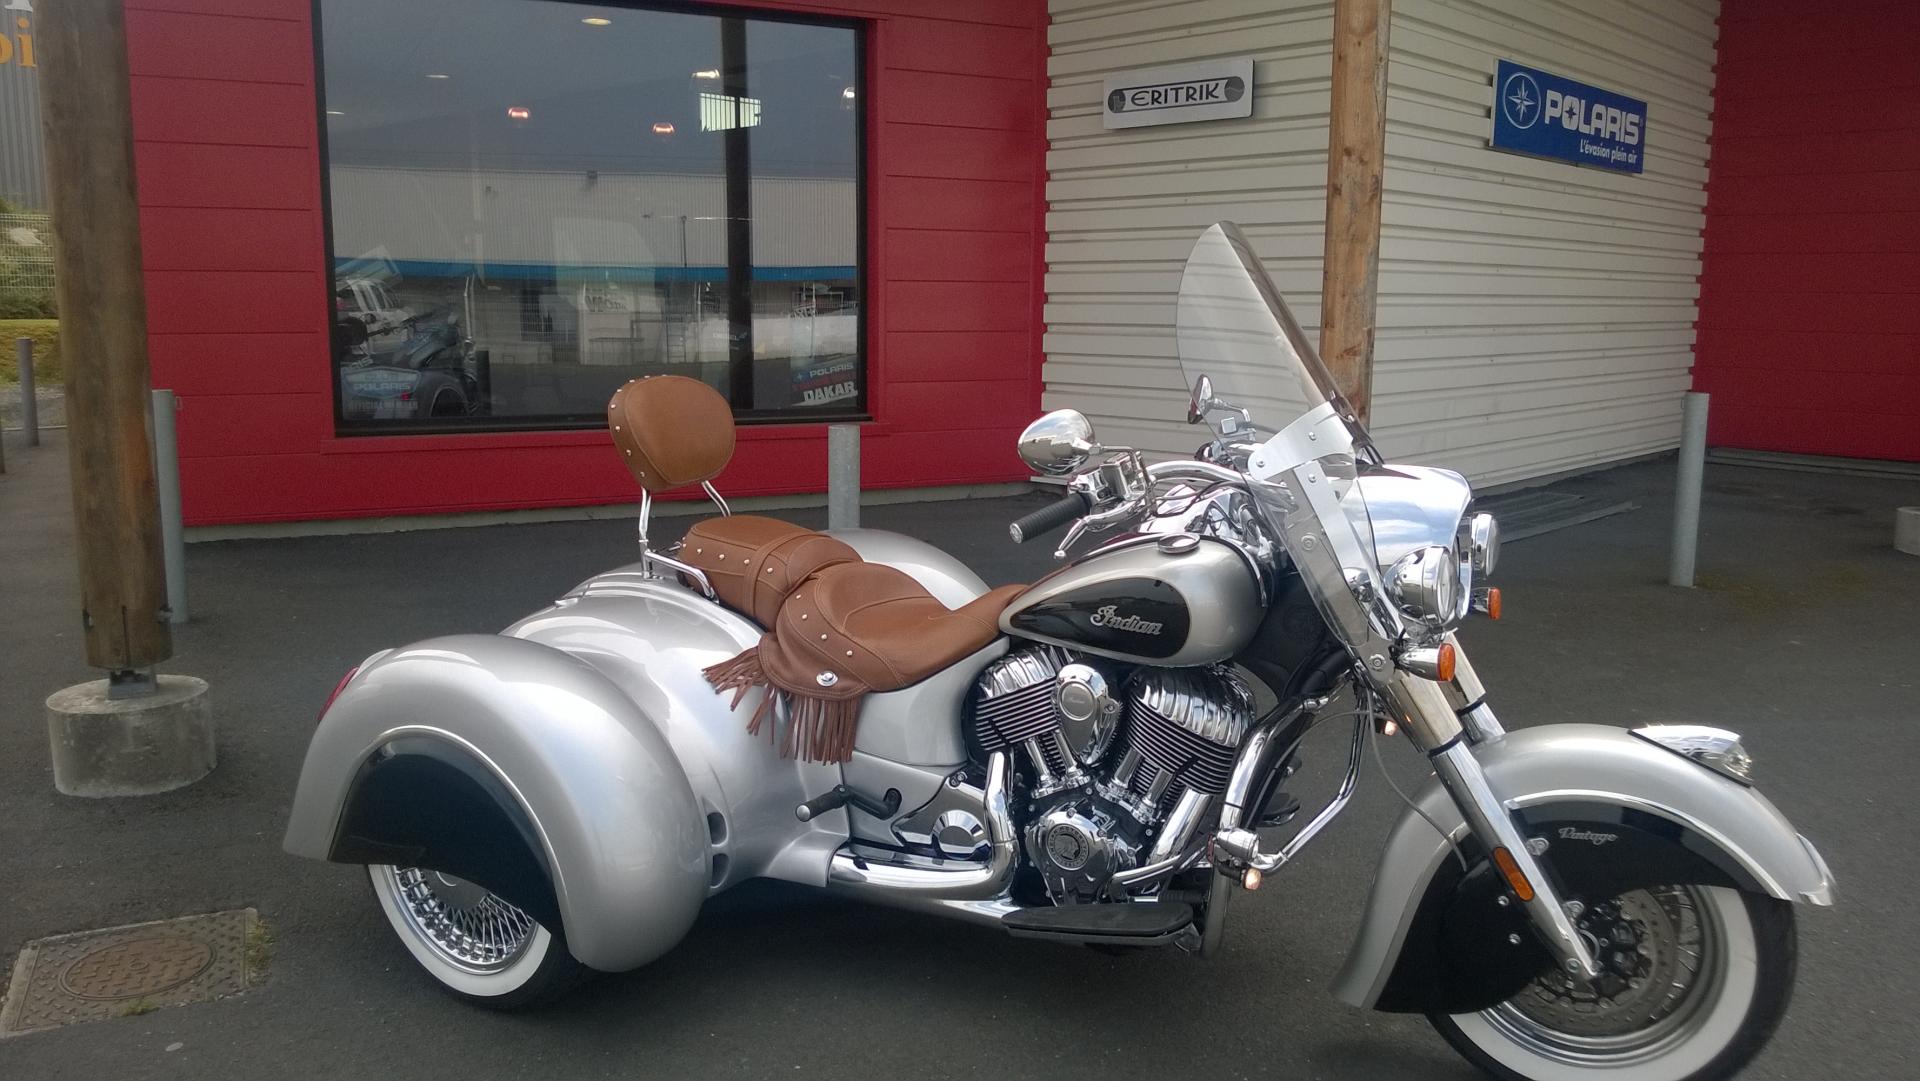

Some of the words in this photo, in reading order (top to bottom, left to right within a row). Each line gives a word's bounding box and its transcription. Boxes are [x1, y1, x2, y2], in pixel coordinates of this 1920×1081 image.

[1130, 82, 1220, 107] ERITRIK
[1544, 89, 1640, 145] POLARIS
[1610, 146, 1627, 164] plein
[1627, 150, 1638, 164] air
[809, 361, 855, 379] POLARIS
[803, 381, 856, 402] DAKAR
[1089, 605, 1163, 635] Indian
